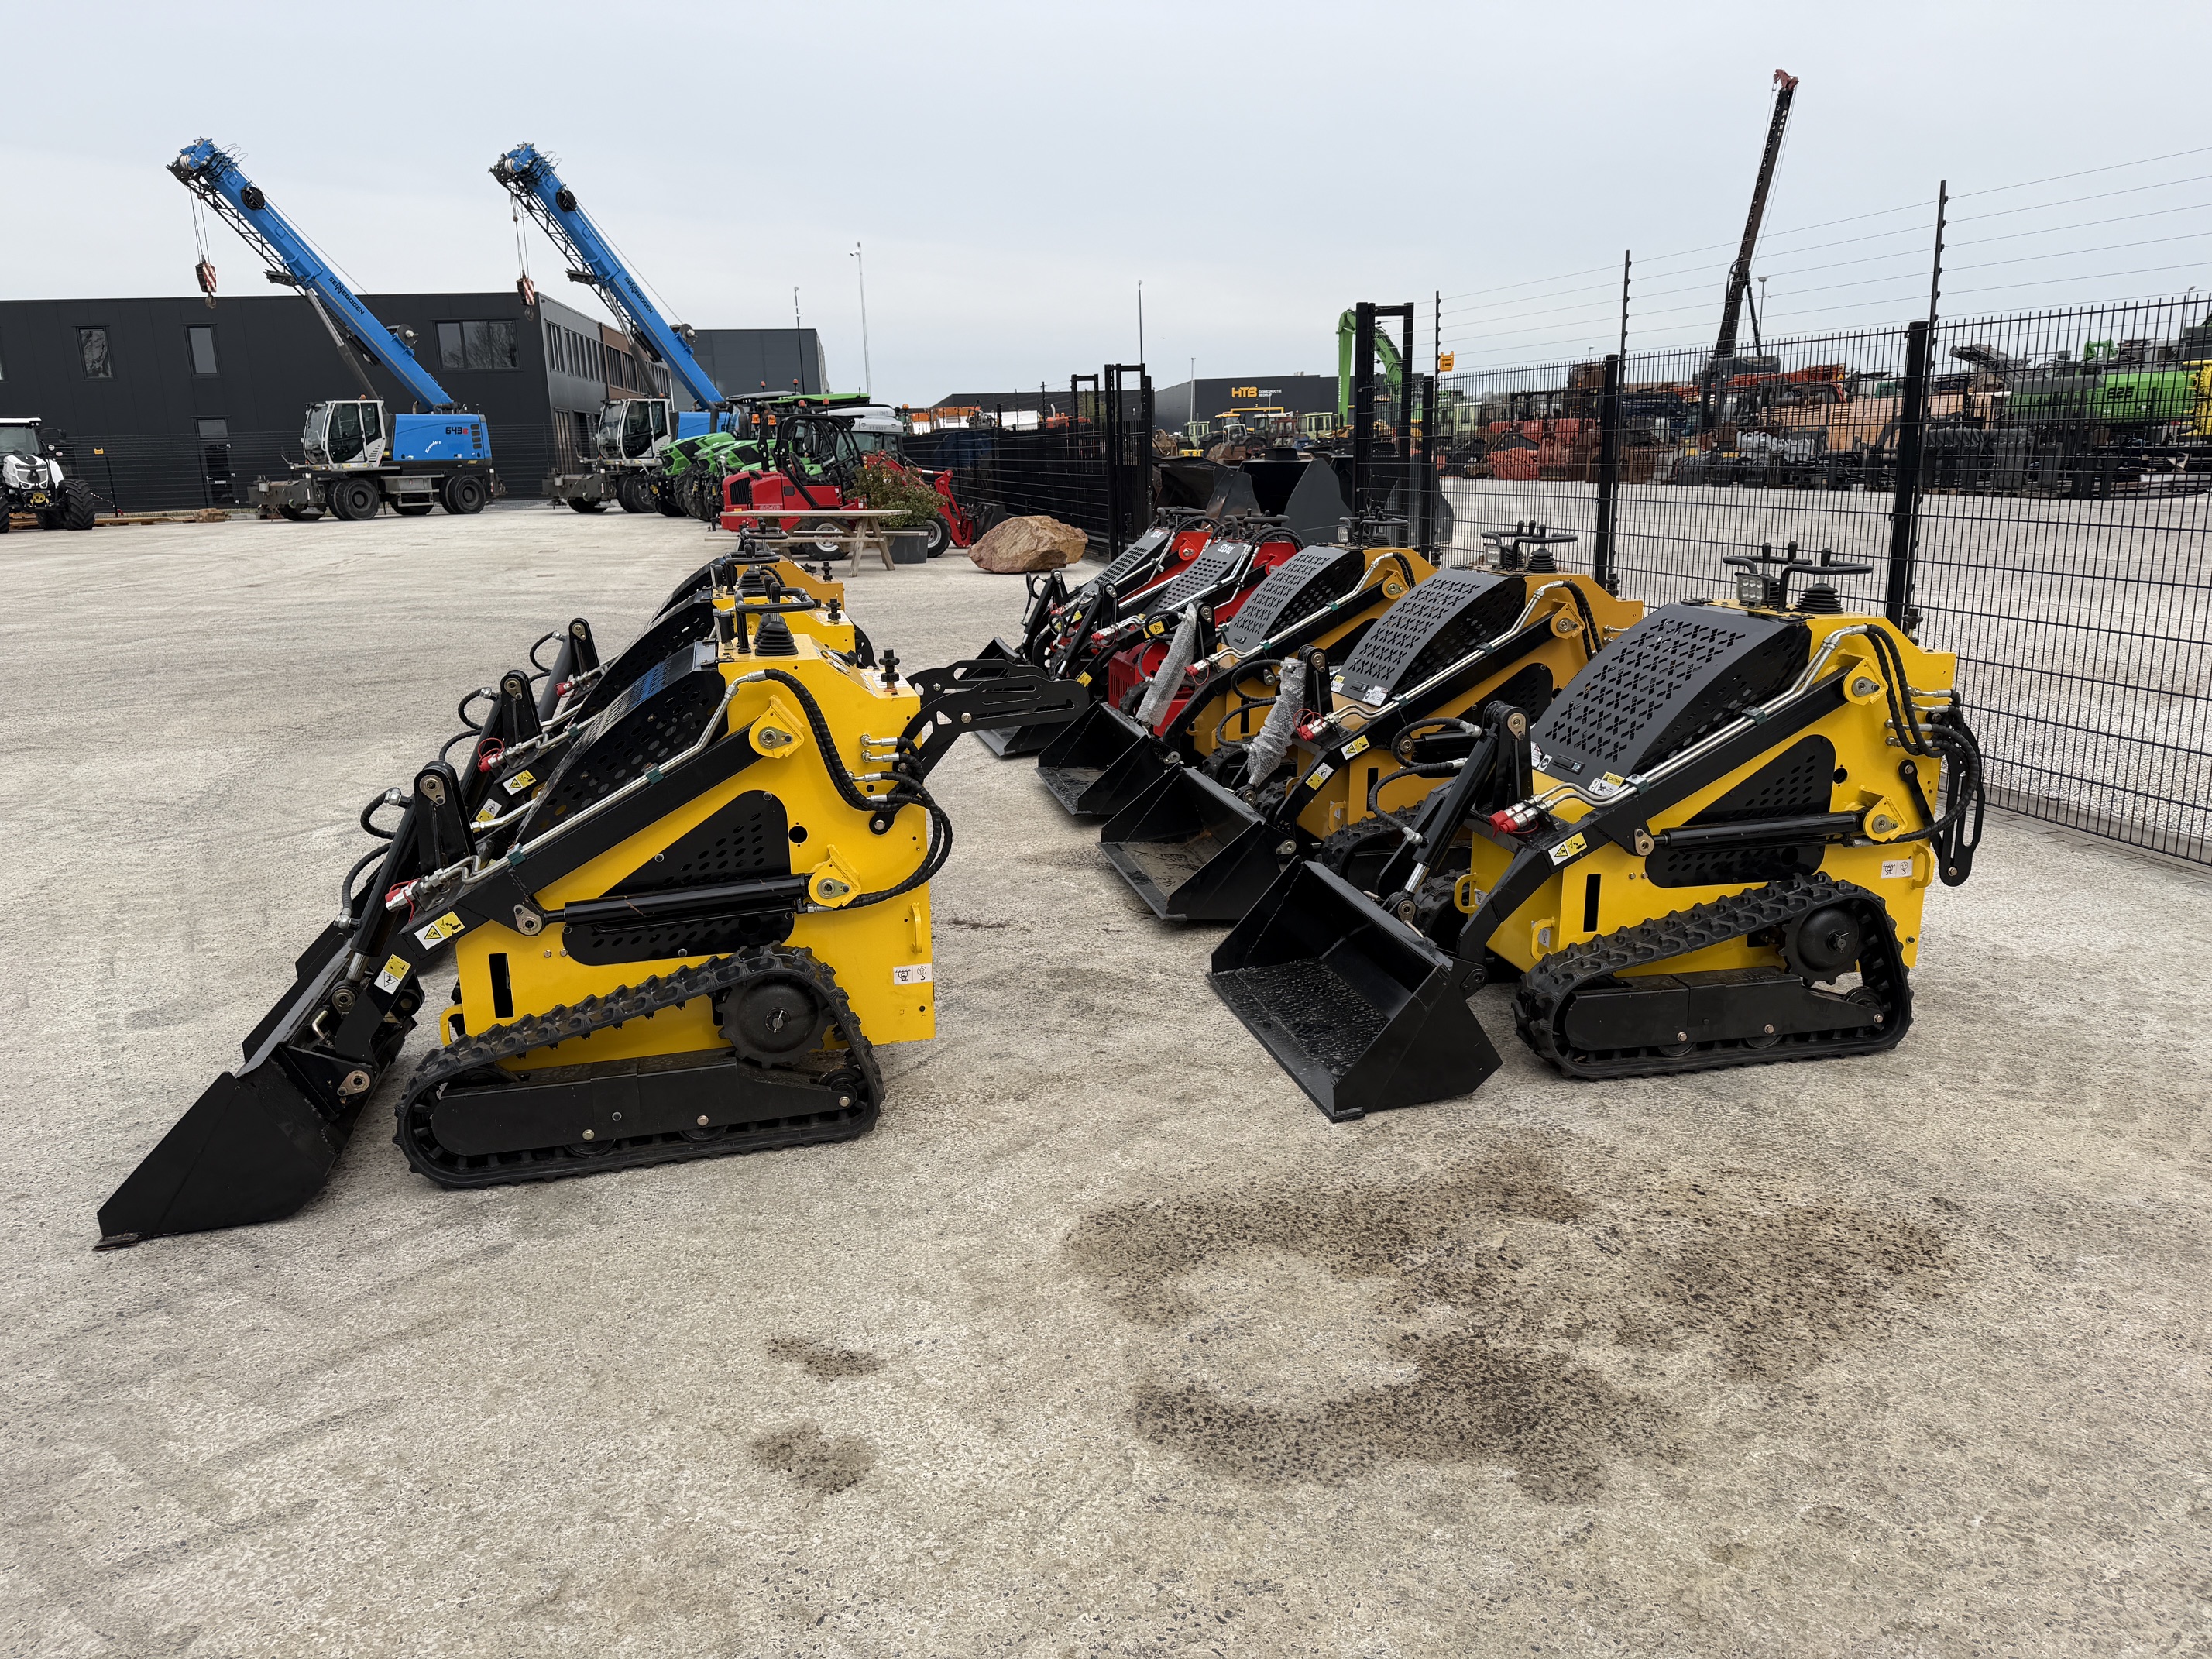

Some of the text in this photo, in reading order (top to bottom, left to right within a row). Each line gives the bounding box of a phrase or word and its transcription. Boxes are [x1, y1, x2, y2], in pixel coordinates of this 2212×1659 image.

[328, 276, 365, 315] SENNEBOGEN
[623, 276, 654, 314] SENNEBOGEN
[1231, 386, 1258, 398] HTB
